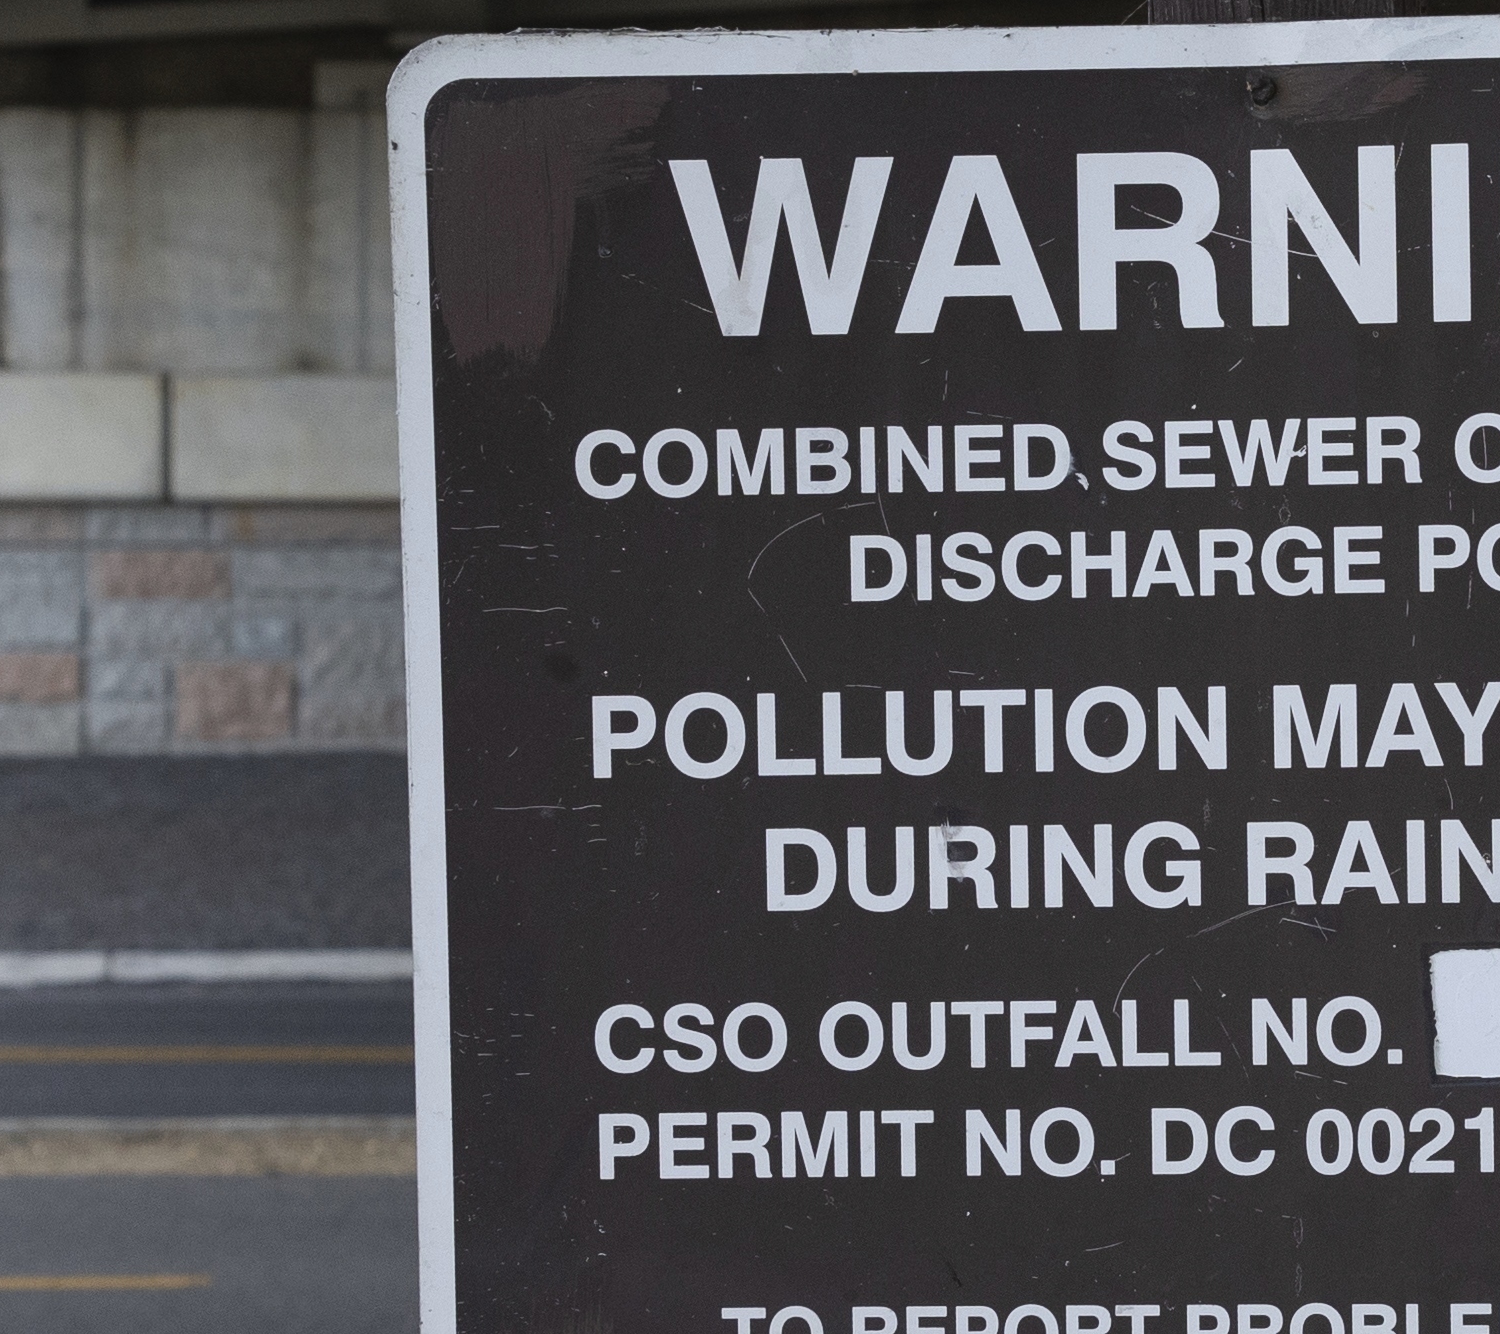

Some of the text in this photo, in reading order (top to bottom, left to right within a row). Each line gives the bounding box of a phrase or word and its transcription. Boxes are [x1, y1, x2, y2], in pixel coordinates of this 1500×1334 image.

[575, 424, 1073, 499] COMBINED
[1102, 416, 1422, 490] SEWER
[850, 526, 1385, 602] DISCHARGE
[592, 686, 1227, 779] POLLUTION
[766, 821, 1201, 912] DURING
[595, 996, 1402, 1073] CSO OUTFALL NO.
[599, 1110, 934, 1179] PERMIT
[966, 1107, 1115, 1177] NO.
[1151, 1106, 1275, 1176] DC
